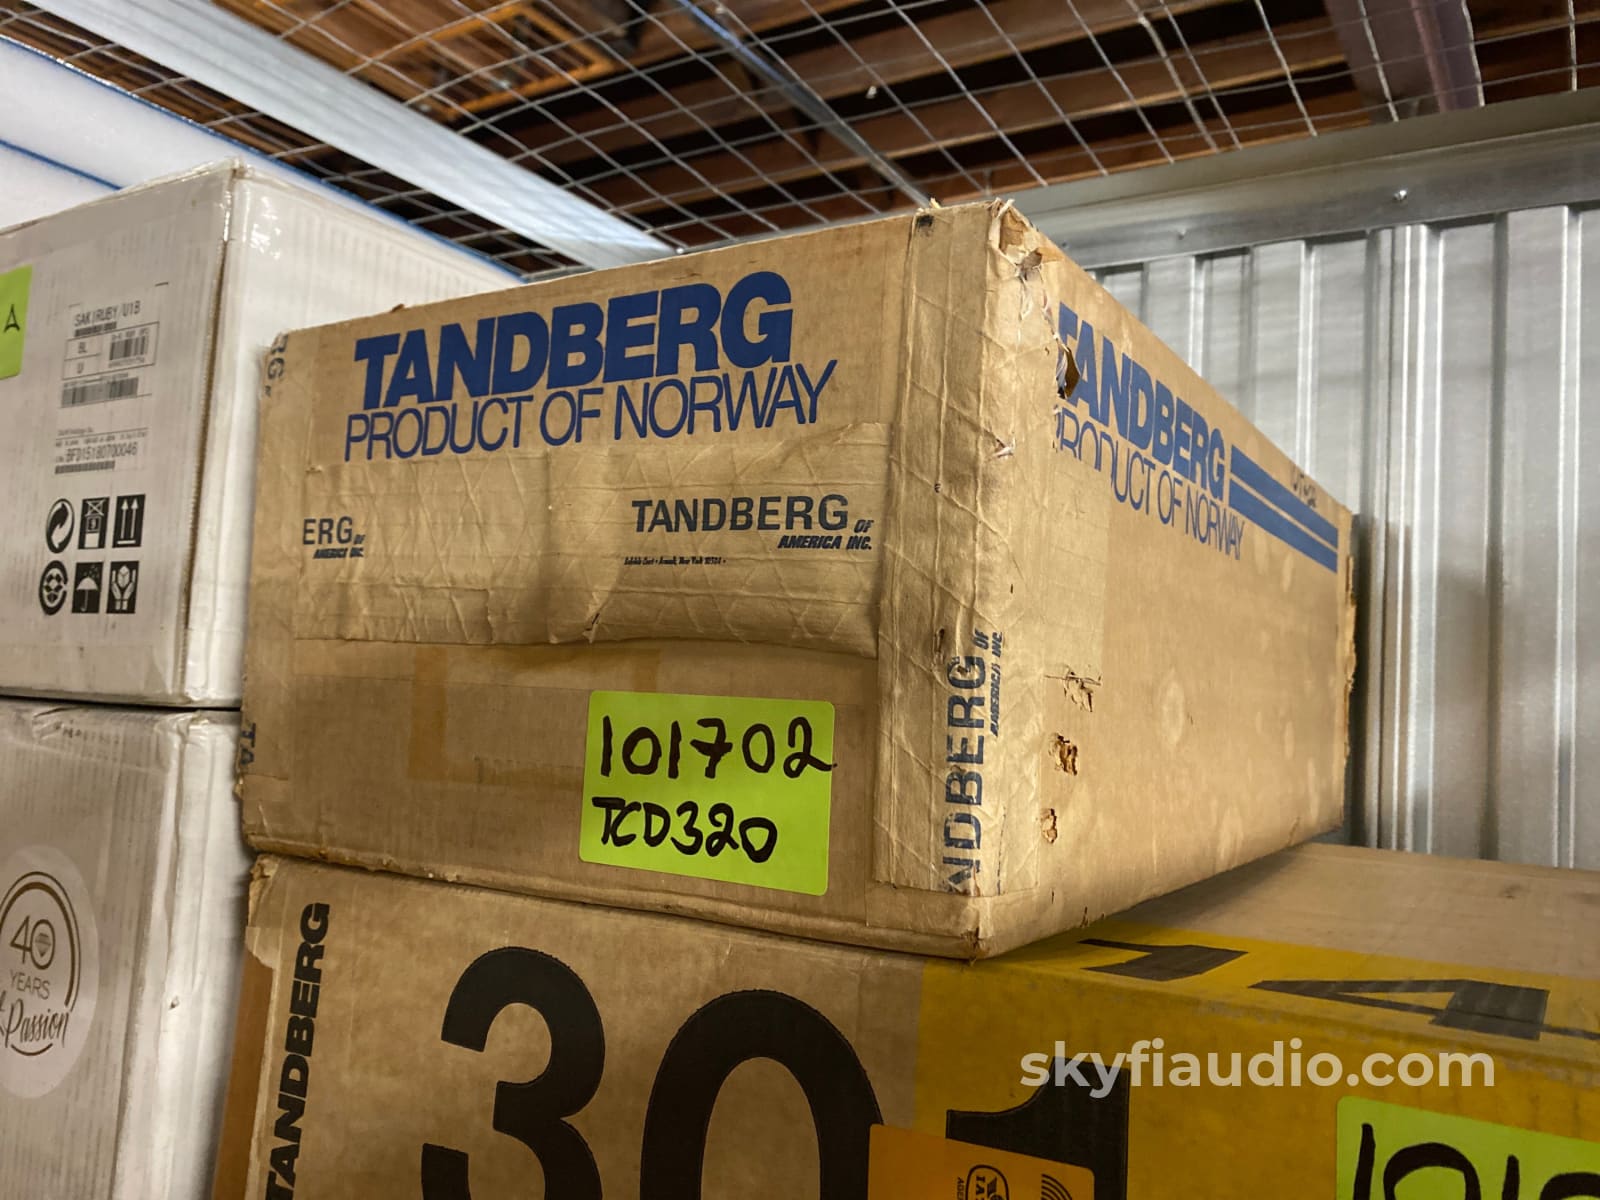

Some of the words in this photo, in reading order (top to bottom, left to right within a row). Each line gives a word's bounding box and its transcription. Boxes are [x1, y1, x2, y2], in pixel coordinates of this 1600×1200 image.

[3, 303, 21, 334] A
[354, 271, 793, 410] TANDBERG
[344, 399, 532, 462] PRODUCT
[540, 387, 604, 444] OF
[614, 359, 838, 441] NORWAY
[1056, 405, 1156, 516] RODUCT
[1156, 469, 1183, 526] OF
[1185, 490, 1246, 561] NORWAY
[302, 515, 353, 546] ERG
[632, 494, 849, 534] TANDBERG
[853, 519, 874, 534] OF
[777, 534, 843, 550] AMERICA
[845, 534, 873, 551] INC.
[973, 628, 990, 650] OF
[599, 714, 838, 780] 101702
[591, 796, 778, 864] TCD320
[9, 915, 56, 970] 40
[9, 968, 51, 1001] YEARS
[4, 998, 70, 1049] Passion
[265, 902, 330, 1200] TANDBERG
